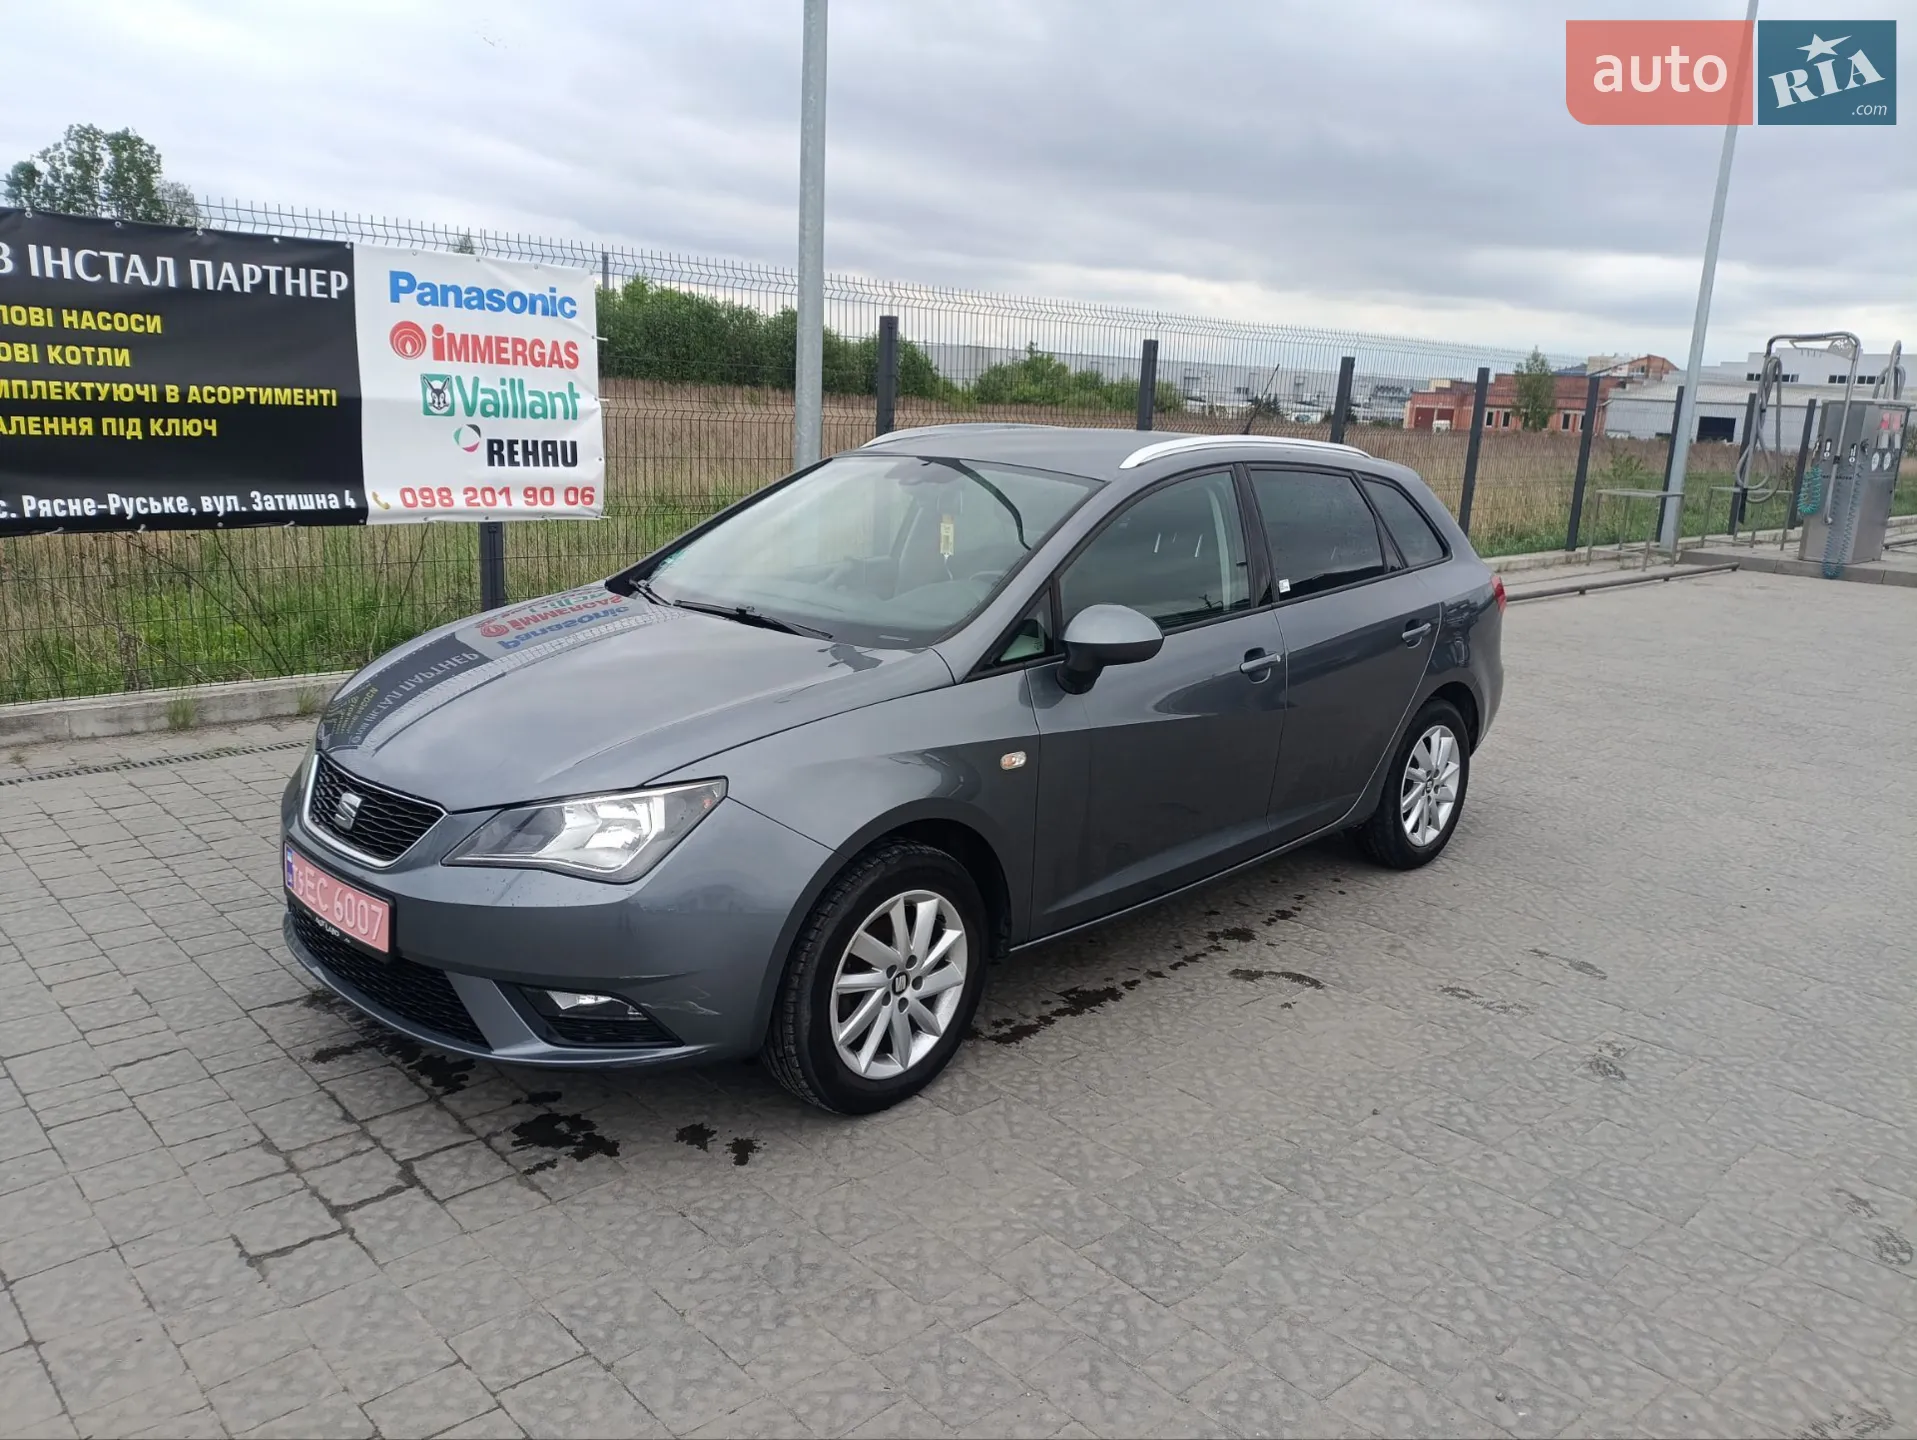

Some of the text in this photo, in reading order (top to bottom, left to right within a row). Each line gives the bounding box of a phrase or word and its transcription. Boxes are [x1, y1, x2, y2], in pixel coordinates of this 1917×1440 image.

[28, 244, 177, 288] ІНСТАЛ
[189, 259, 349, 299] ПАРТНЕР
[389, 270, 577, 319] Panasonic
[62, 309, 162, 334] НАСОСИ
[47, 344, 131, 367] КОТЛИ
[165, 384, 180, 403] В
[187, 385, 337, 406] АСОРТИМЕНТІ
[455, 375, 581, 421] Vaillant
[102, 417, 143, 440] ПІД
[150, 418, 217, 437] КЛЮЧ
[487, 439, 578, 468] REHAU
[200, 495, 246, 516] вул.
[250, 490, 340, 512] Затишна
[345, 489, 356, 509] 4
[400, 486, 595, 508] 098 201 90 06
[334, 887, 383, 940] 6007
